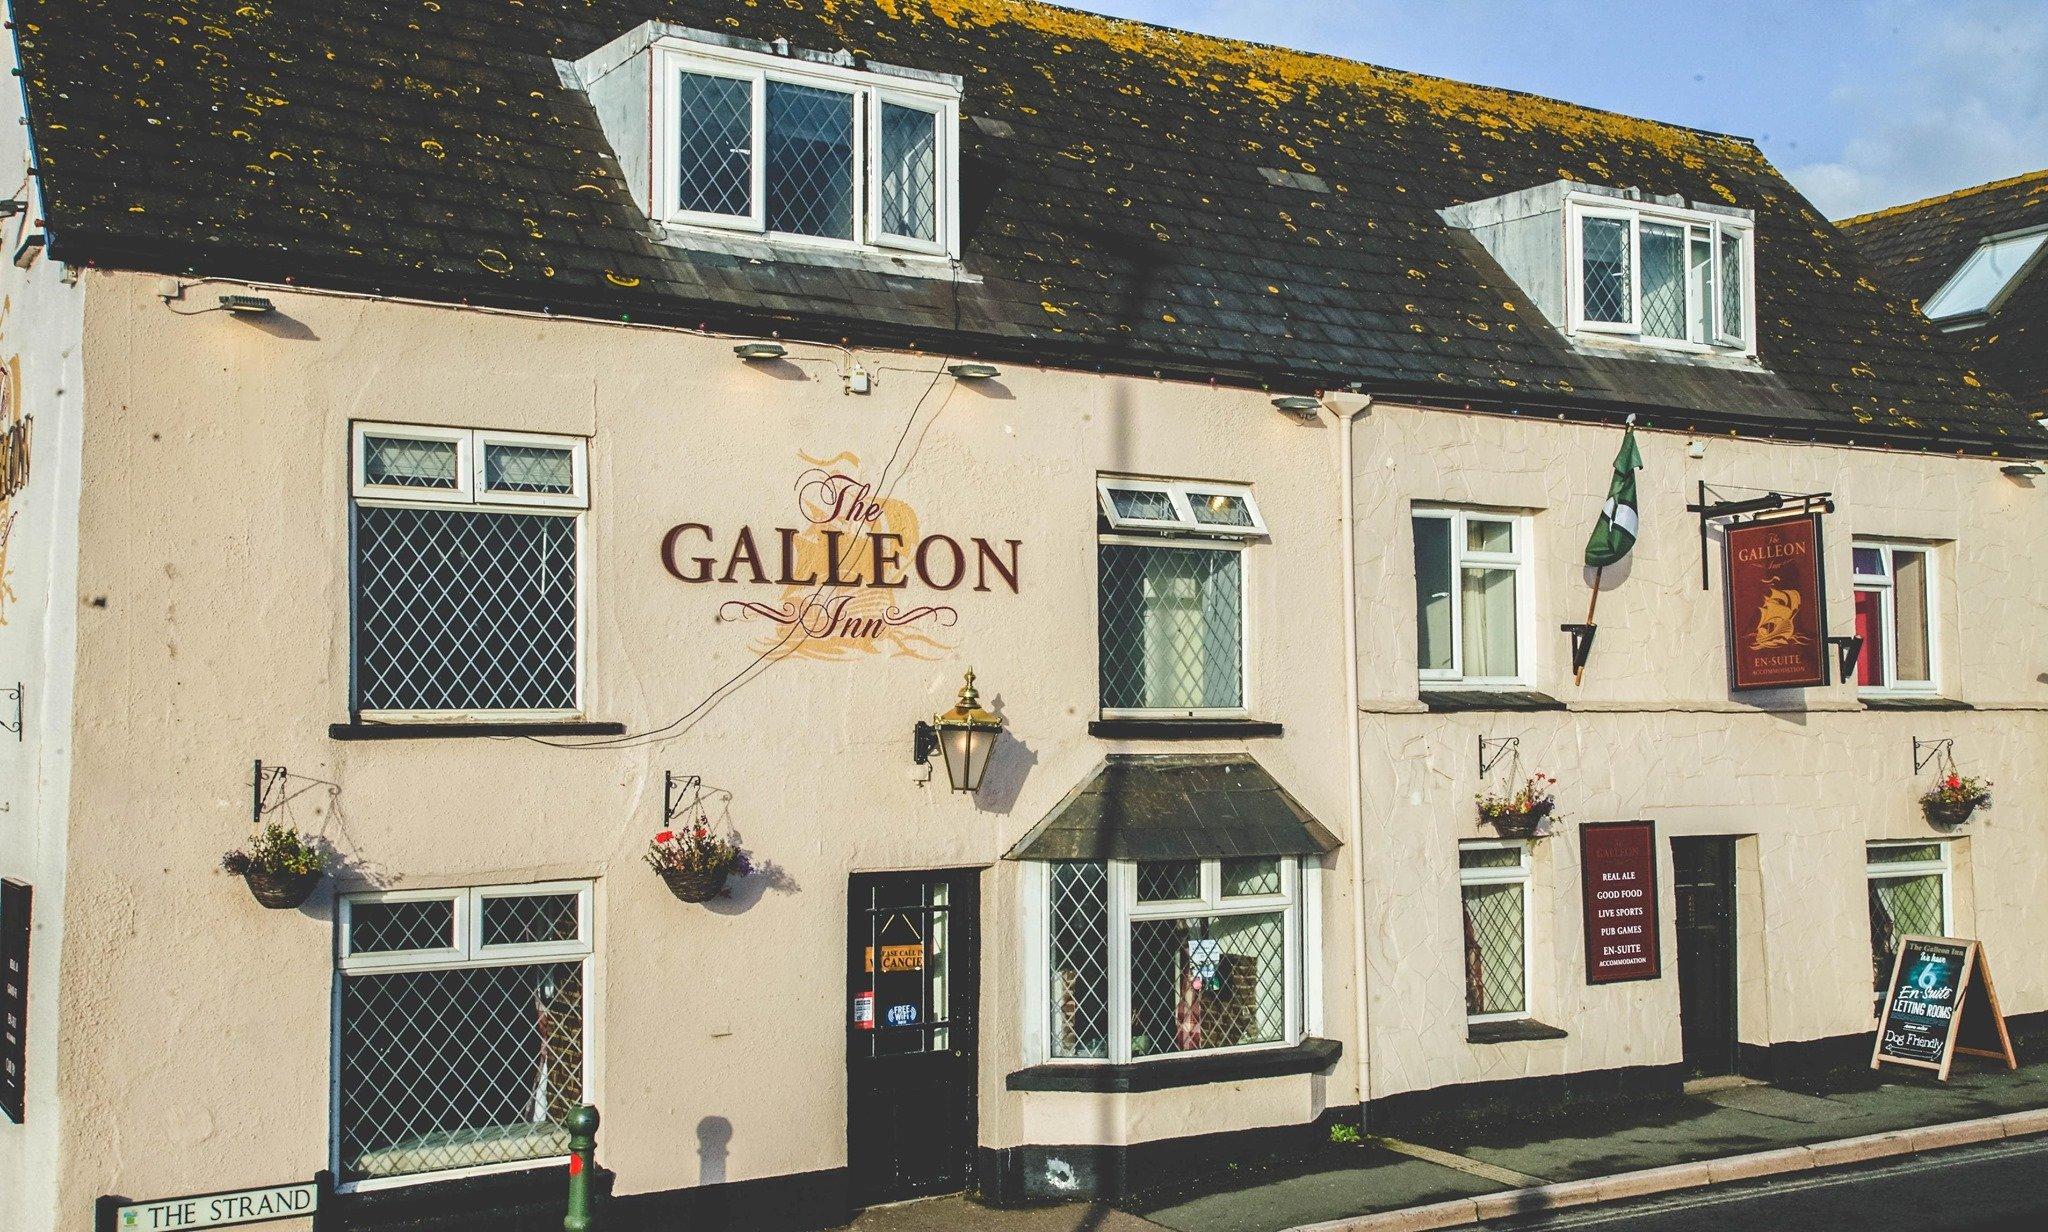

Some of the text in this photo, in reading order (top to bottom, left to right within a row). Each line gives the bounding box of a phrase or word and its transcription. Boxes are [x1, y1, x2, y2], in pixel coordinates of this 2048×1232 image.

[794, 468, 885, 525] The
[660, 522, 1023, 594] GALLEON
[1738, 541, 1806, 563] GALLEON
[799, 595, 888, 640] Inn
[1754, 654, 1801, 668] EN-SUITE
[1602, 871, 1636, 882] REAL ALE
[1597, 889, 1643, 900] GOOD FOOD
[1598, 907, 1643, 918] LIVE SPORTS
[1601, 925, 1642, 936] PUB GAMES
[1603, 944, 1642, 956] EN-SUITE
[1909, 943, 1922, 951] The
[870, 957, 923, 968] VCANCIE
[1599, 957, 1647, 967] ACCOMMODATION
[1918, 963, 1937, 988] 6
[1898, 985, 1953, 999] En-Suite
[894, 1005, 911, 1014] FREE
[1893, 999, 1953, 1020] LETTING ROOMS
[1885, 1030, 1944, 1054] Dog Friendly
[148, 1189, 311, 1229] THE STRAND
